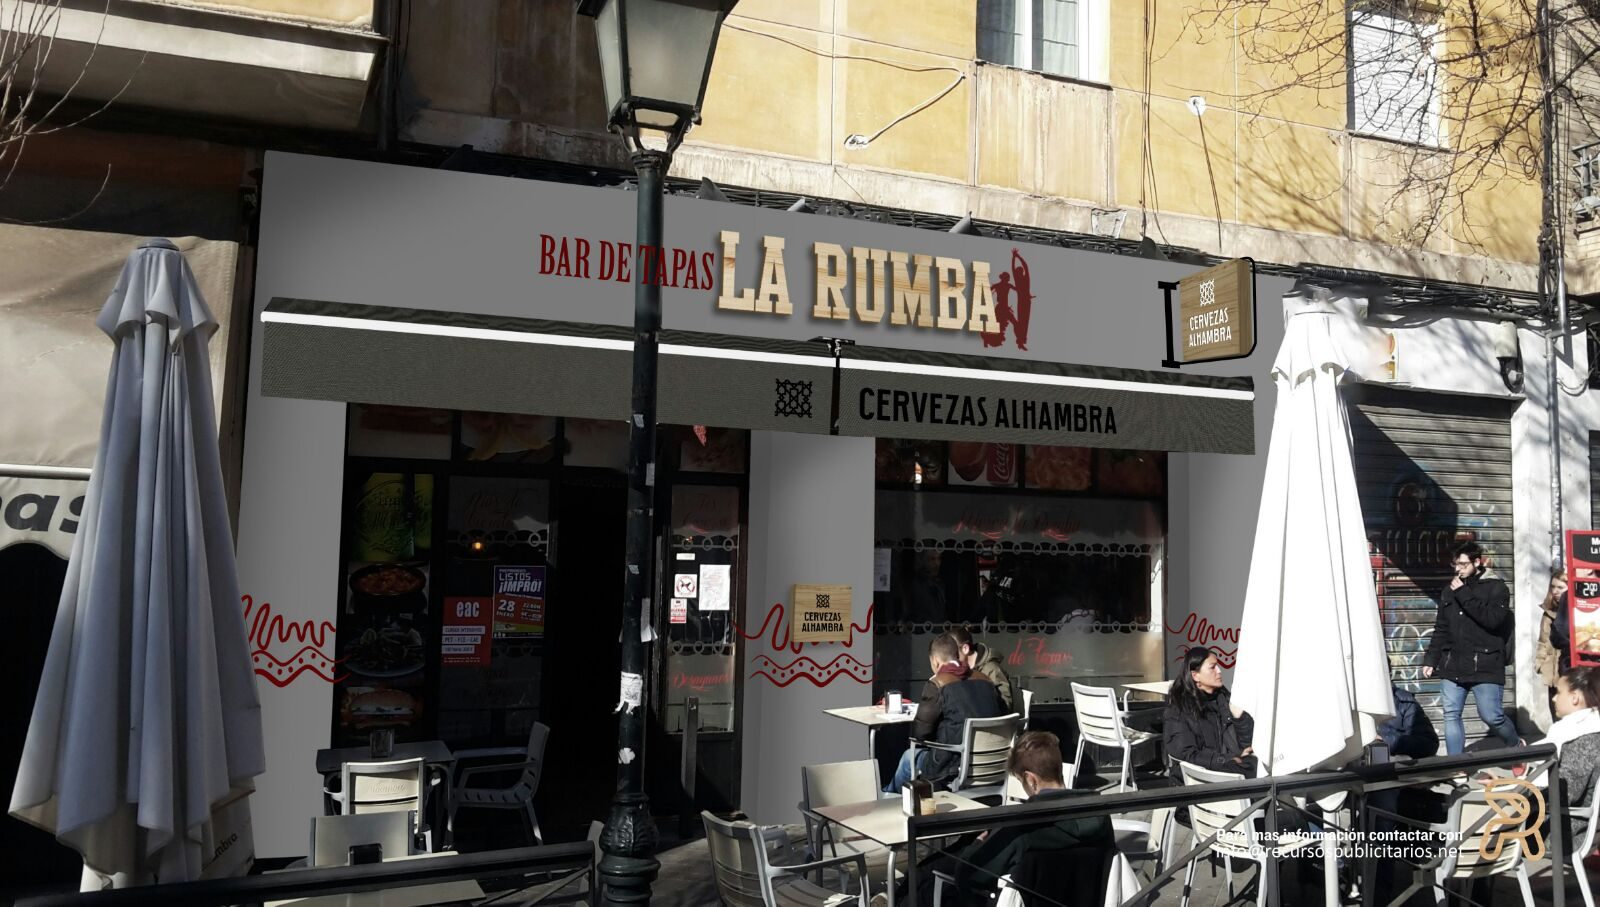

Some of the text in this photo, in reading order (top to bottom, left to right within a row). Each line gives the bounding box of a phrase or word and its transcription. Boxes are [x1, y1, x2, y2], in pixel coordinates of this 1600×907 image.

[539, 234, 715, 291] BAR DE TAPAS
[719, 230, 1000, 334] LA RUMBA
[1189, 307, 1229, 331] CERVEZAS
[1188, 325, 1232, 347] ALHAMBRA
[859, 387, 1117, 434] CERVEZAS ALHAMBRA
[498, 580, 543, 594] ¡IMPRO!
[456, 601, 480, 618] eac
[497, 599, 516, 612] 28
[804, 611, 841, 622] CERVEZAS
[801, 622, 844, 632] ALHAMBRA
[213, 832, 238, 857] mbra
